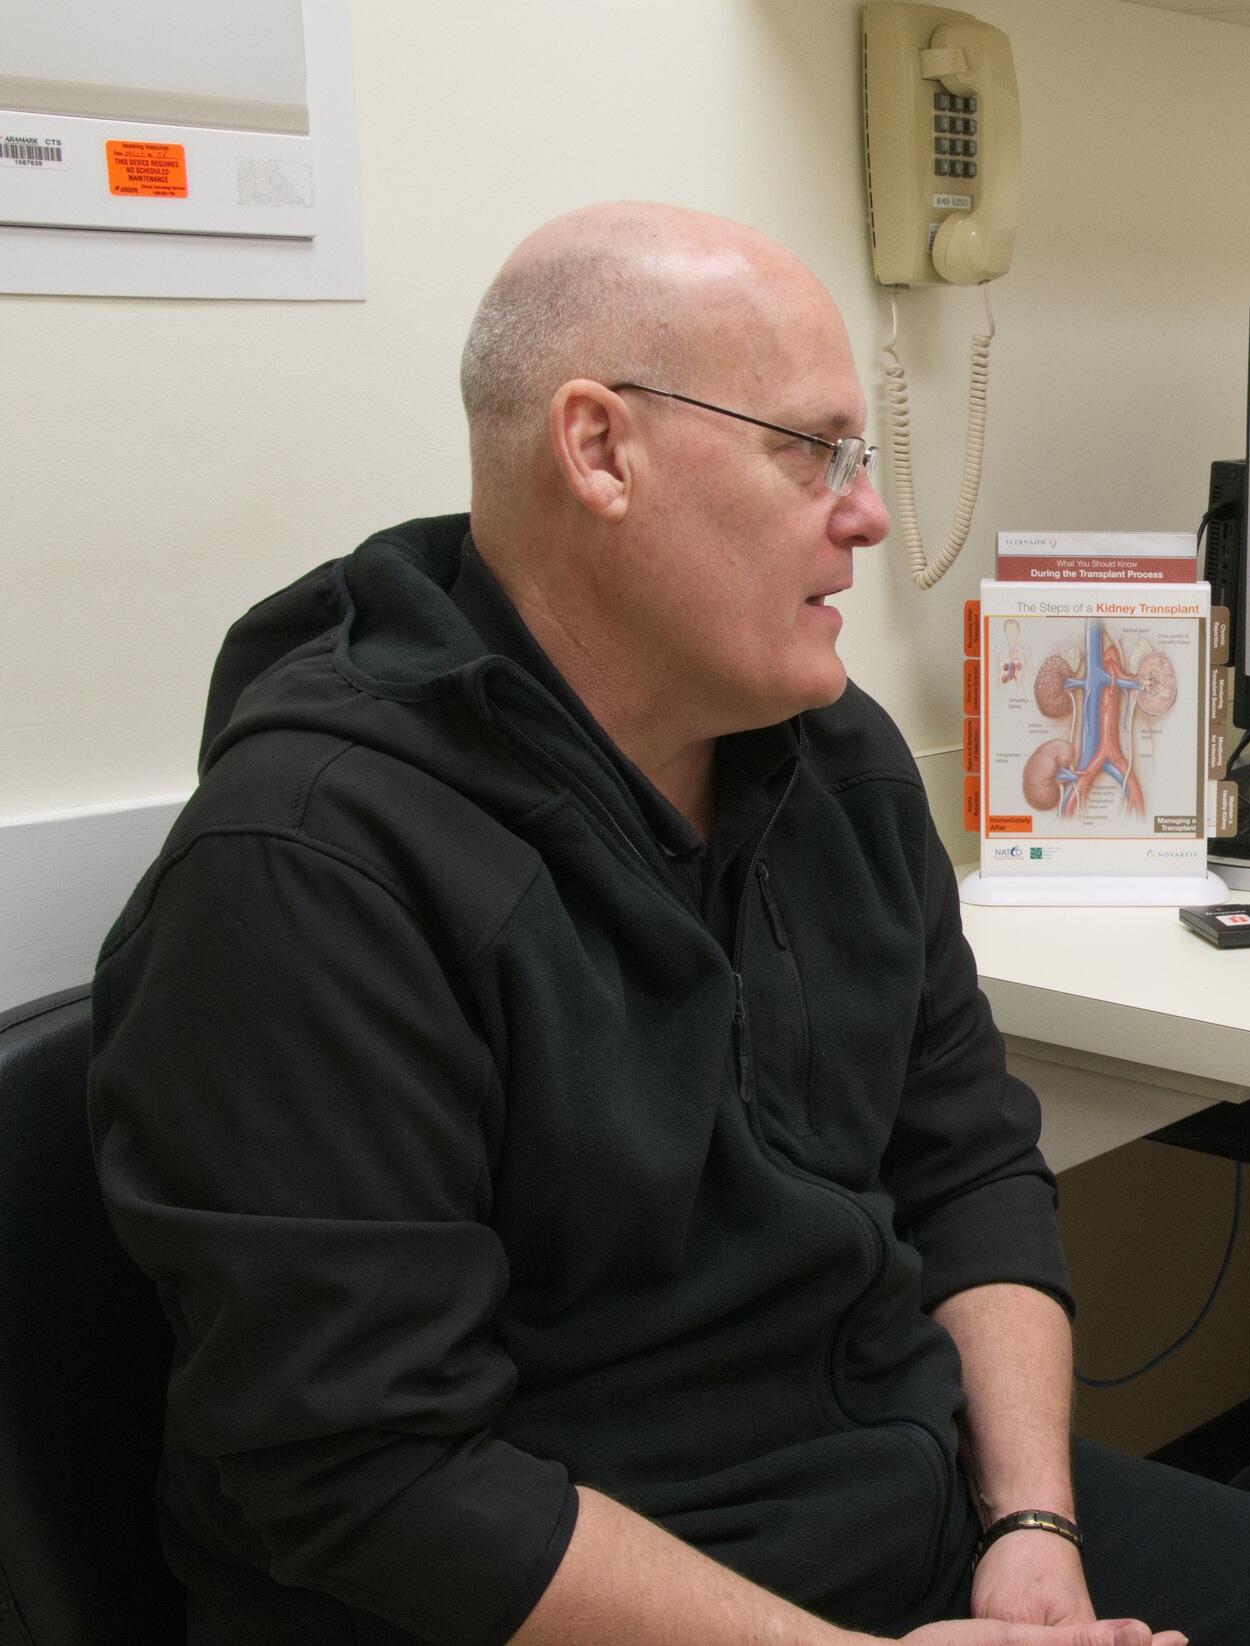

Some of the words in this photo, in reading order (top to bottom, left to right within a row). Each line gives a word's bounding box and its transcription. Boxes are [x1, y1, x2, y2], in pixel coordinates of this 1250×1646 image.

[5, 136, 38, 144] ARAMARK
[45, 138, 62, 146] CTS
[151, 160, 179, 168] REQUIRES
[128, 175, 168, 183] MAINTENANCE
[1056, 560, 1075, 568] What
[1076, 560, 1090, 568] You
[1092, 560, 1114, 568] Should
[1116, 560, 1138, 568] Know
[1030, 570, 1060, 580] During
[1062, 570, 1077, 578] the
[1079, 570, 1126, 580] Transplant
[1127, 570, 1164, 579] Process
[1016, 602, 1037, 612] The
[1040, 602, 1070, 614] Steps
[1073, 602, 1085, 612] of
[1096, 604, 1136, 616] Kidney
[1138, 604, 1200, 616] Transplant
[990, 817, 1032, 826] Immediately
[1158, 818, 1188, 826] Managing
